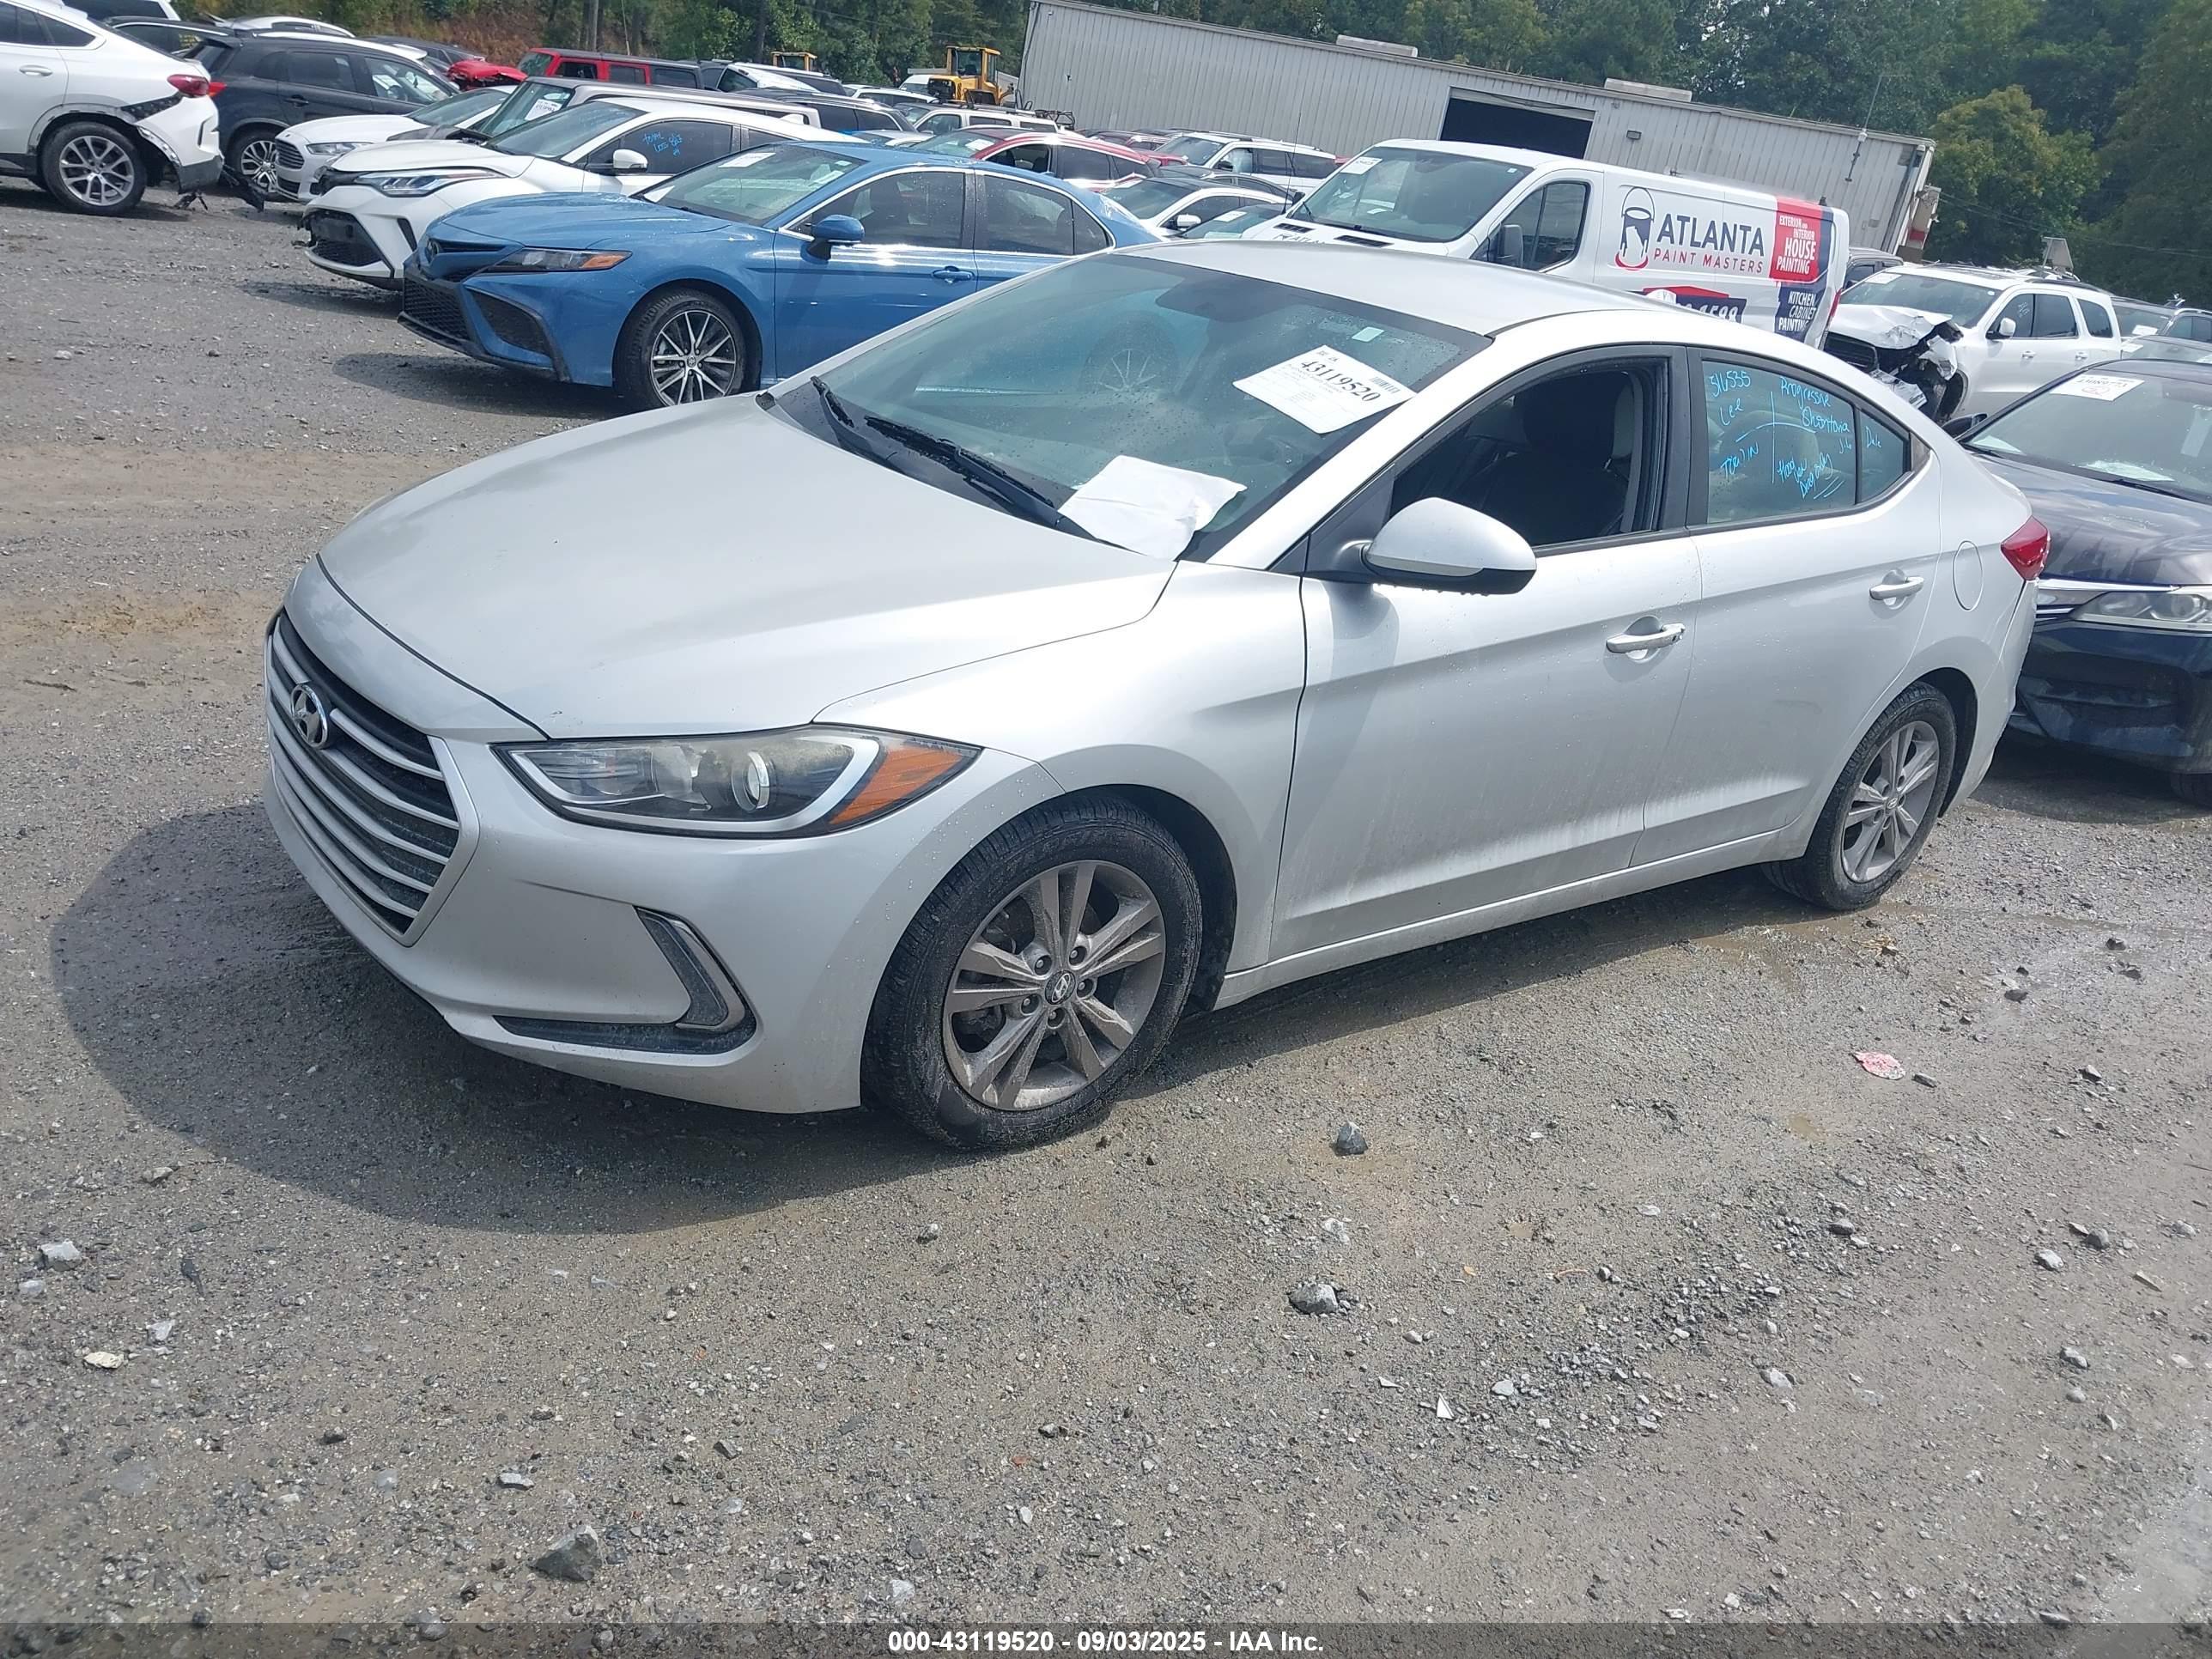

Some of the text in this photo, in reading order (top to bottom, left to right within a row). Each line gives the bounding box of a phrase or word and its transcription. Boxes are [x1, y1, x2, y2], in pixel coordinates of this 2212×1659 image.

[1779, 216, 1802, 228] EXTERIOR
[1656, 213, 1765, 257] ATLANTA
[1793, 228, 1815, 240] INTERIOR
[1784, 237, 1817, 260] HOUSE
[1654, 248, 1764, 273] PAINT MASTERS
[1776, 256, 1811, 275] PAINTING
[1788, 291, 1817, 307] KITCHEN
[1789, 305, 1817, 320] CABINET
[1301, 361, 1381, 402] 43119520
